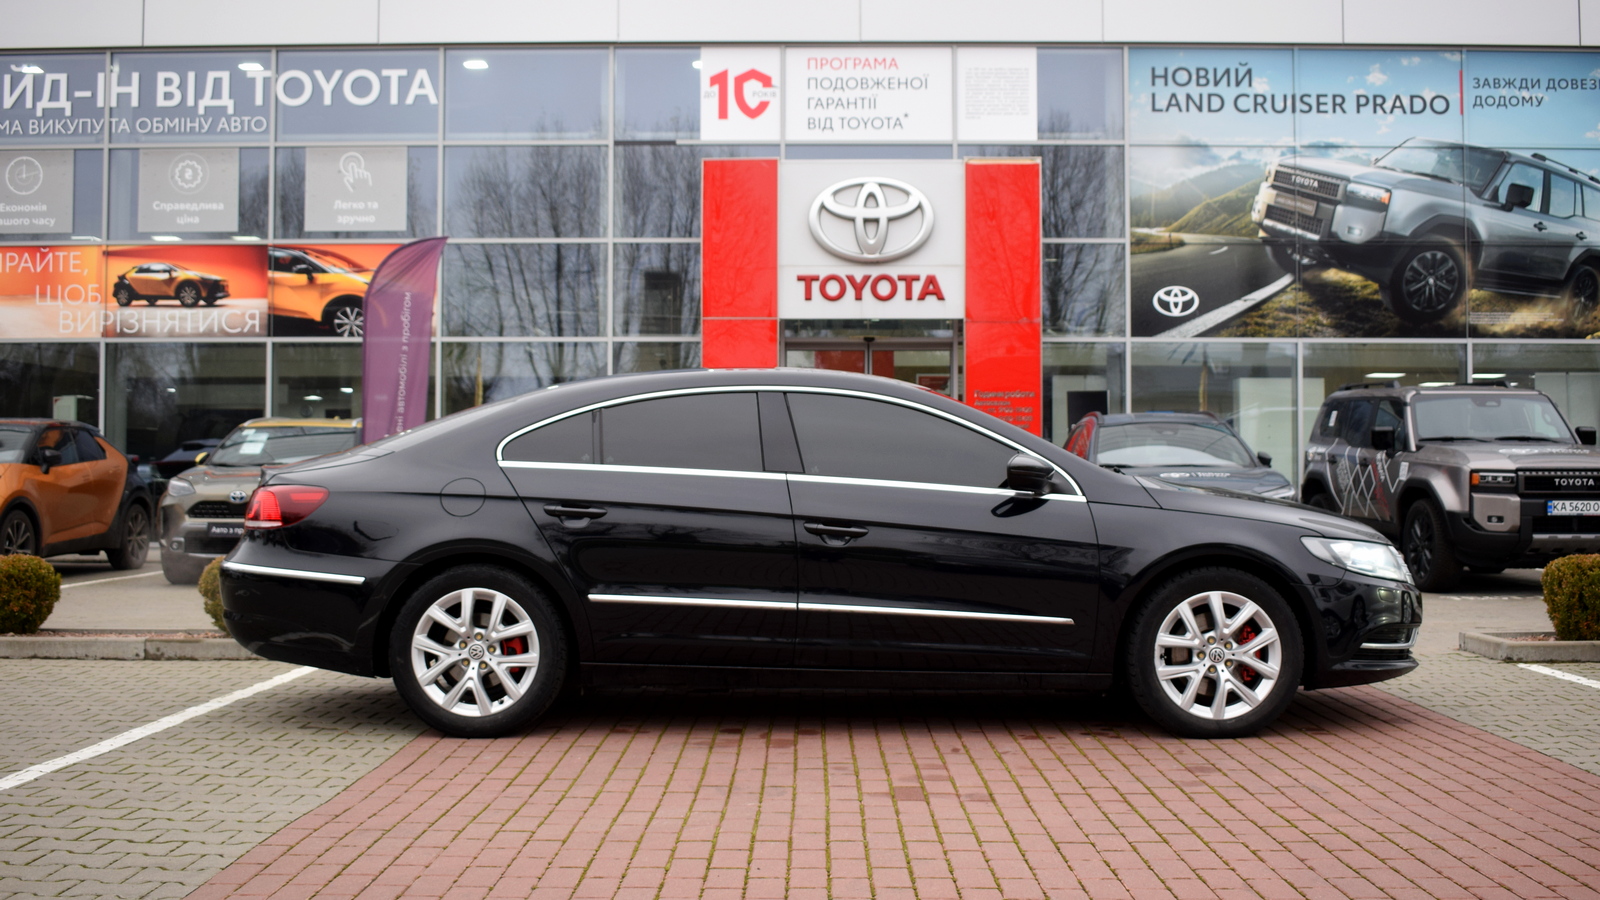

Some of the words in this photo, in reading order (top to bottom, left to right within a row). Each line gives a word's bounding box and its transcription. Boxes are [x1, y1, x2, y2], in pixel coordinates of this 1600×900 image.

[807, 57, 899, 70] ПРОГРАМА
[1151, 62, 1252, 87] НОВИЙ
[807, 73, 930, 92] ПОДОВЖЕНОЇ
[1472, 77, 1541, 92] ЗАВЖДИ
[1545, 78, 1600, 92] ДОВЕЗ
[156, 70, 235, 115] ВІД
[246, 68, 440, 107] TOYOTA
[807, 93, 878, 109] ГАРАНТІЇ
[1151, 92, 1225, 114] LAND
[1233, 93, 1347, 115] CRUISER
[1356, 94, 1451, 115] PRADO
[1472, 95, 1544, 109] ДОДОМУ
[28, 118, 105, 135] ВИКУПУ
[110, 118, 131, 134] ТА
[136, 116, 212, 134] ОБМІНУ
[217, 116, 268, 133] АВТО
[807, 117, 834, 132] ВІД
[1291, 175, 1319, 188] TOYOTA
[152, 201, 224, 212] Справедлива
[333, 200, 365, 209] Легко
[367, 201, 379, 209] та
[32, 217, 56, 227] часу
[176, 213, 200, 225] ціна
[337, 215, 376, 225] зручно
[0, 247, 88, 276] РАЙТЕ,
[796, 274, 945, 302] TOYOTA
[35, 284, 102, 308] ЩОБ
[59, 309, 260, 334] ВИРІЗНЯТИСЯ
[400, 291, 412, 343] пробігом
[396, 353, 408, 414] автомобілі
[1554, 478, 1595, 486] TOYOTA
[1553, 502, 1567, 512] KA
[1569, 502, 1592, 512] 5620
